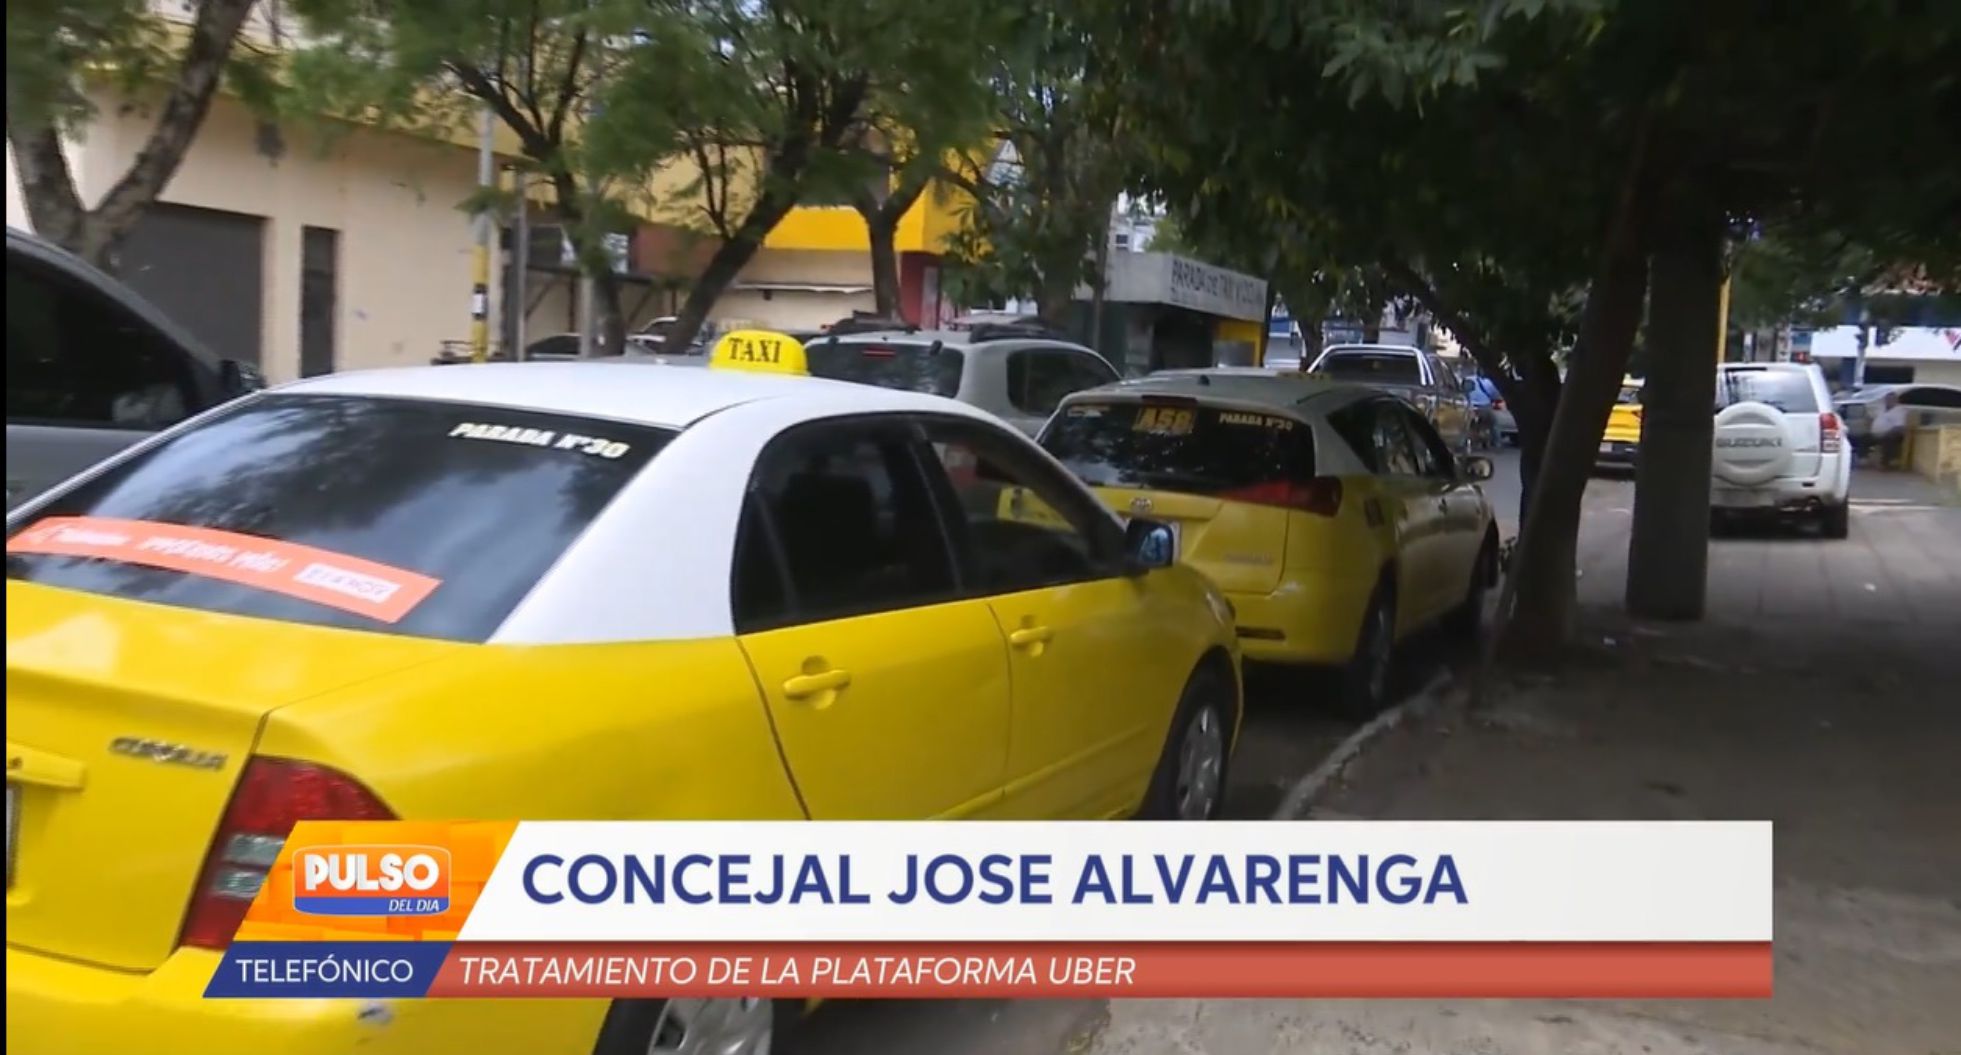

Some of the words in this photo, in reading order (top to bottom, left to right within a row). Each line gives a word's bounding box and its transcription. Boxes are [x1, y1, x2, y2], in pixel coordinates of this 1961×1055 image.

[1172, 259, 1205, 292] PARADA
[728, 337, 781, 363] TAXI
[1219, 412, 1262, 426] PARADA
[448, 422, 555, 446] PARADA
[1716, 437, 1782, 448] SUZUKI
